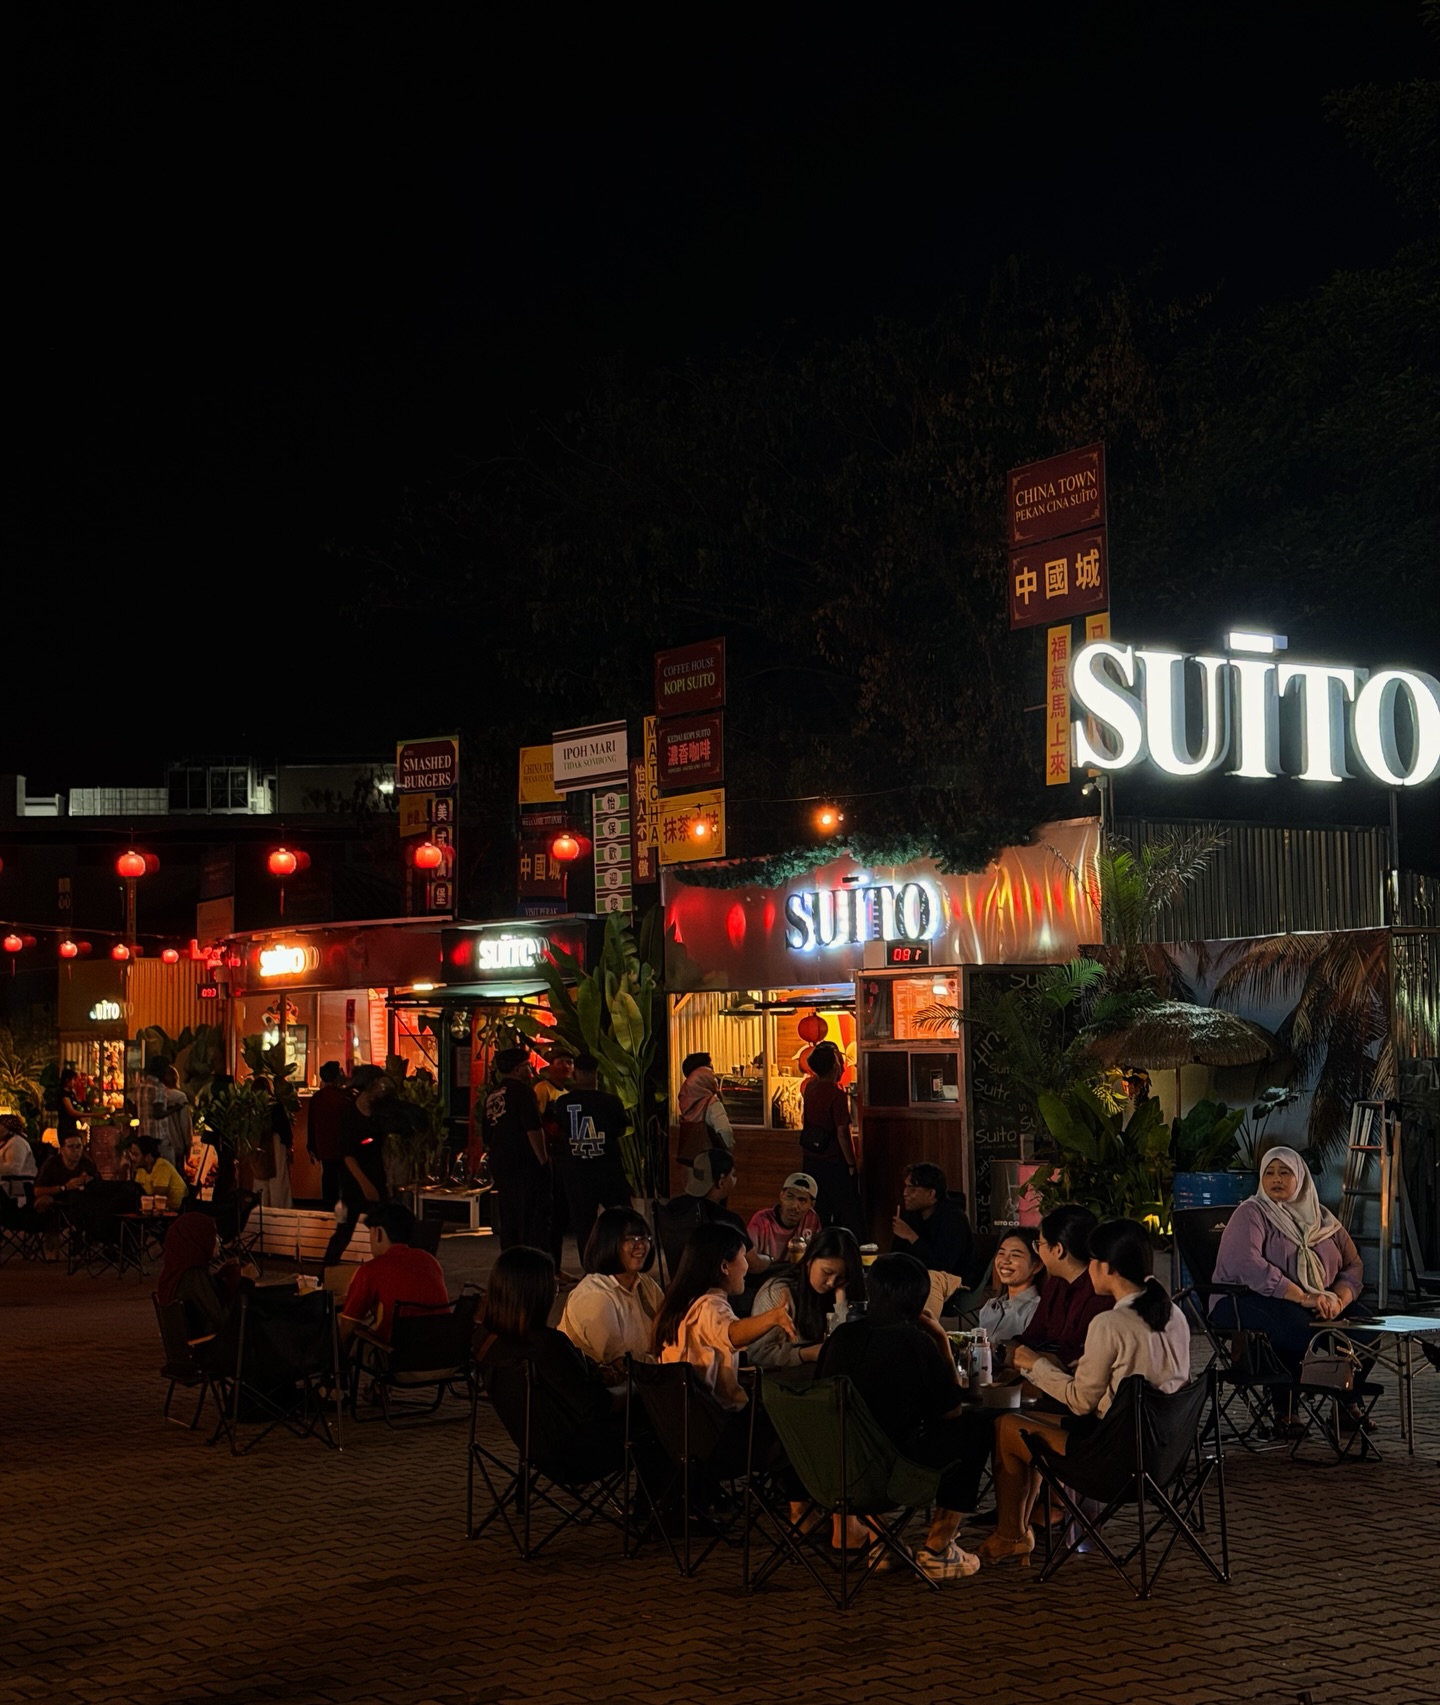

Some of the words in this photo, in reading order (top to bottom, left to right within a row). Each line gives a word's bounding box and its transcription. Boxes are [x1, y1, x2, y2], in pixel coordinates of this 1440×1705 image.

[1015, 482, 1056, 507] CHINA
[1058, 469, 1096, 494] TOWN
[1015, 503, 1046, 522] PEKAN
[1047, 497, 1069, 514] CINA
[1015, 548, 1101, 605] 中國城
[663, 662, 691, 677] COFFEE
[691, 656, 716, 671] HOUSE
[664, 678, 686, 695] KOPI
[1050, 636, 1068, 776] 福氣馬上來
[563, 745, 588, 760] IPOH
[590, 740, 616, 756] MARI
[403, 755, 452, 772] SMASHED
[563, 760, 582, 771] TIDAK
[583, 755, 617, 767] SOMBONG
[403, 772, 452, 789] BURGERS
[647, 720, 659, 843] MATCHA
[663, 810, 719, 844] 抹茶味
[567, 1104, 606, 1156] LA
[975, 1126, 1017, 1144] Suito
